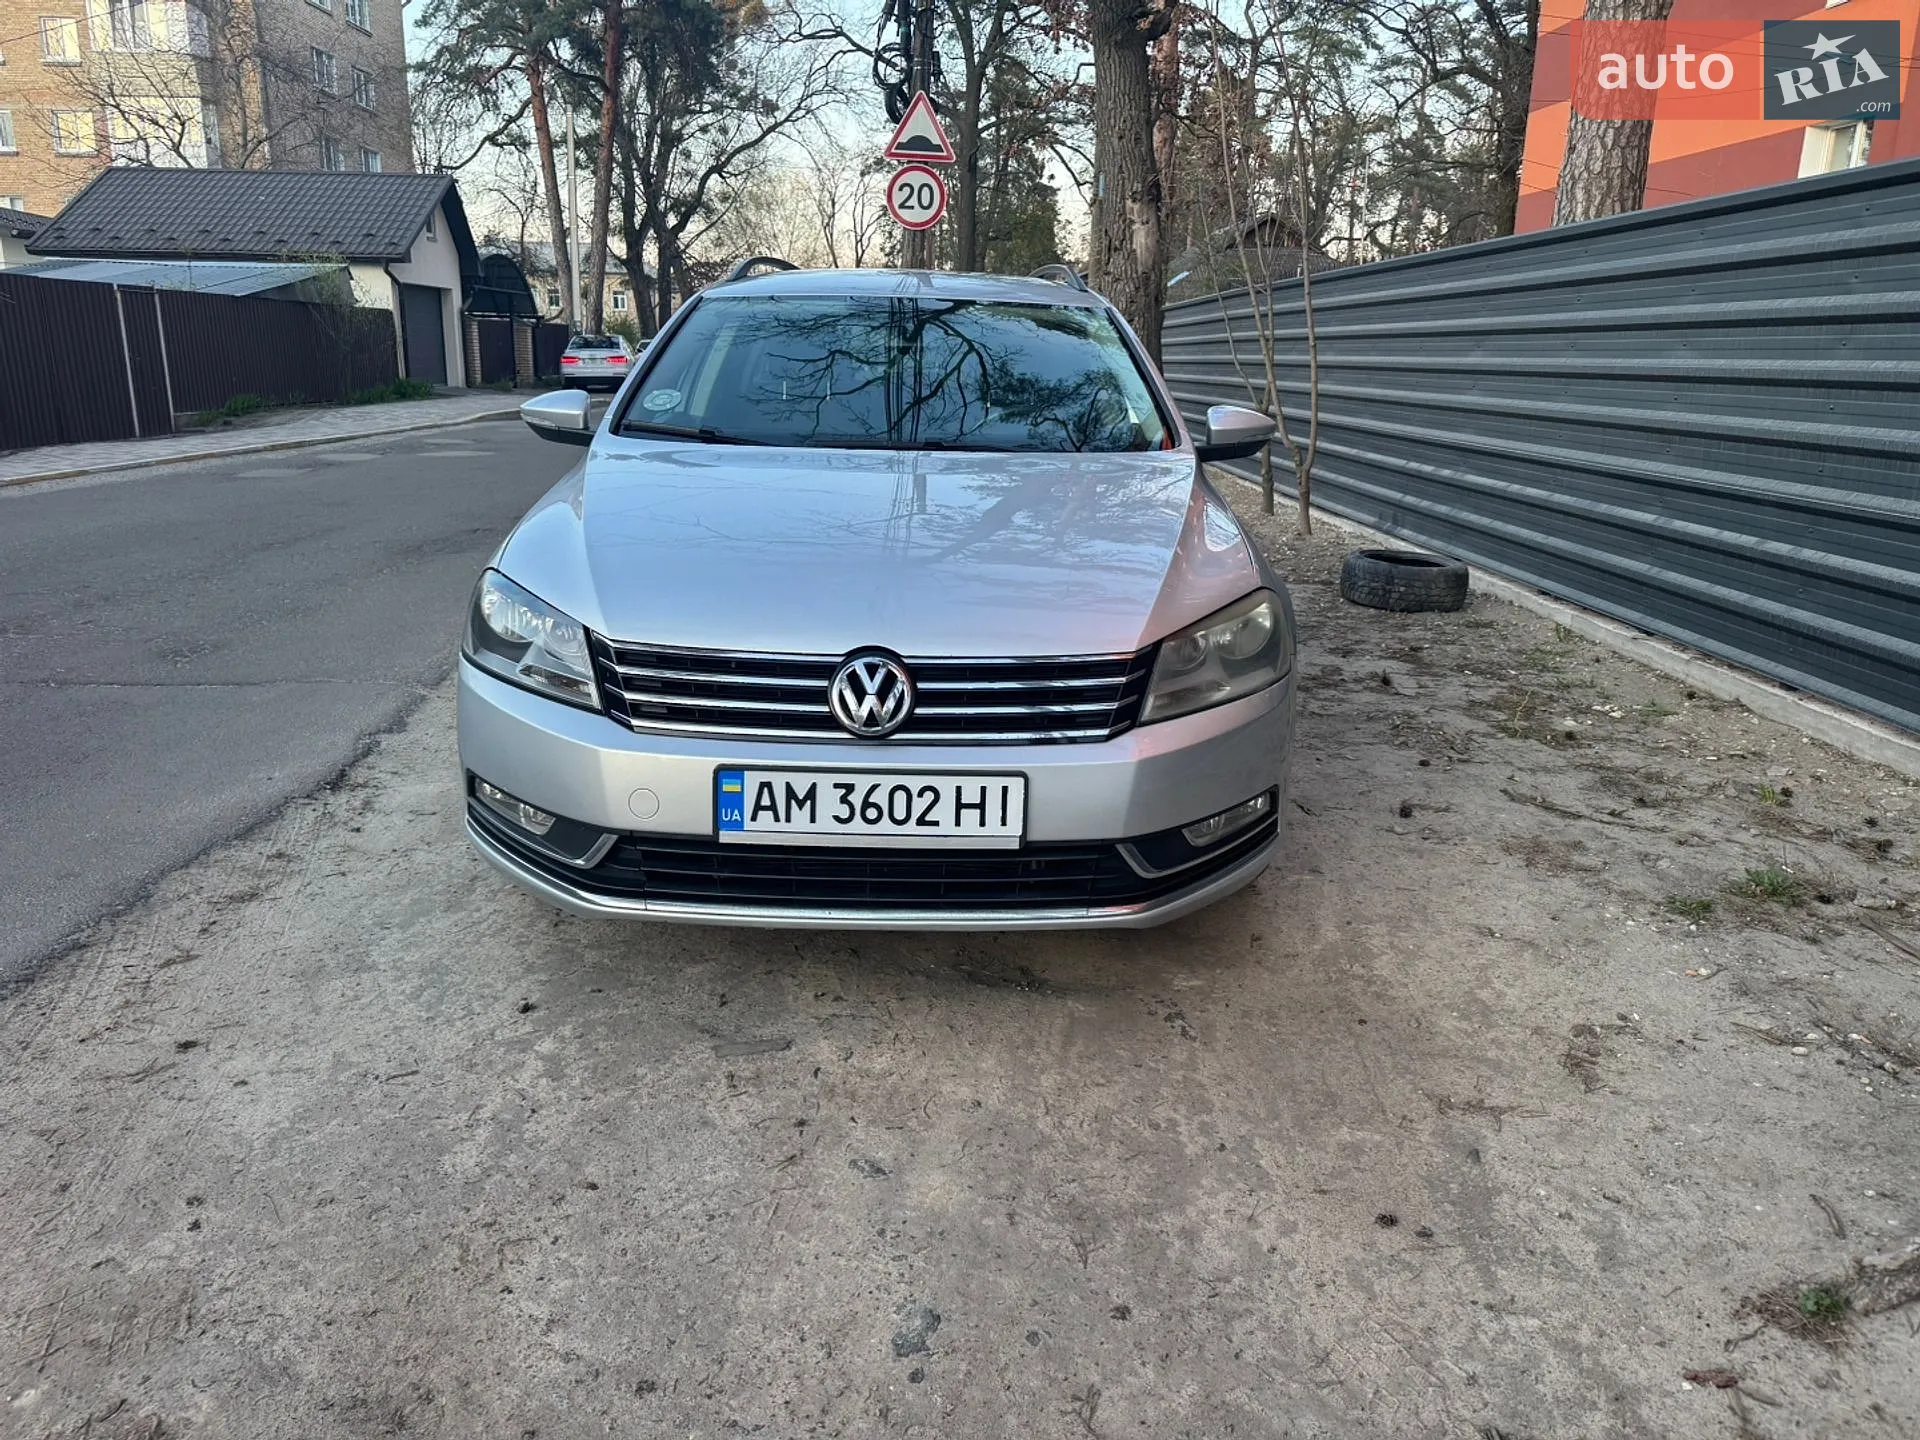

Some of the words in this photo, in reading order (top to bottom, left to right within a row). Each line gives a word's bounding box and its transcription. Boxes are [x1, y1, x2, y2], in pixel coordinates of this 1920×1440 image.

[897, 182, 935, 211] 20
[721, 807, 742, 823] UA
[750, 780, 817, 824] AM
[831, 782, 941, 827] 3602
[954, 785, 1009, 827] HI
